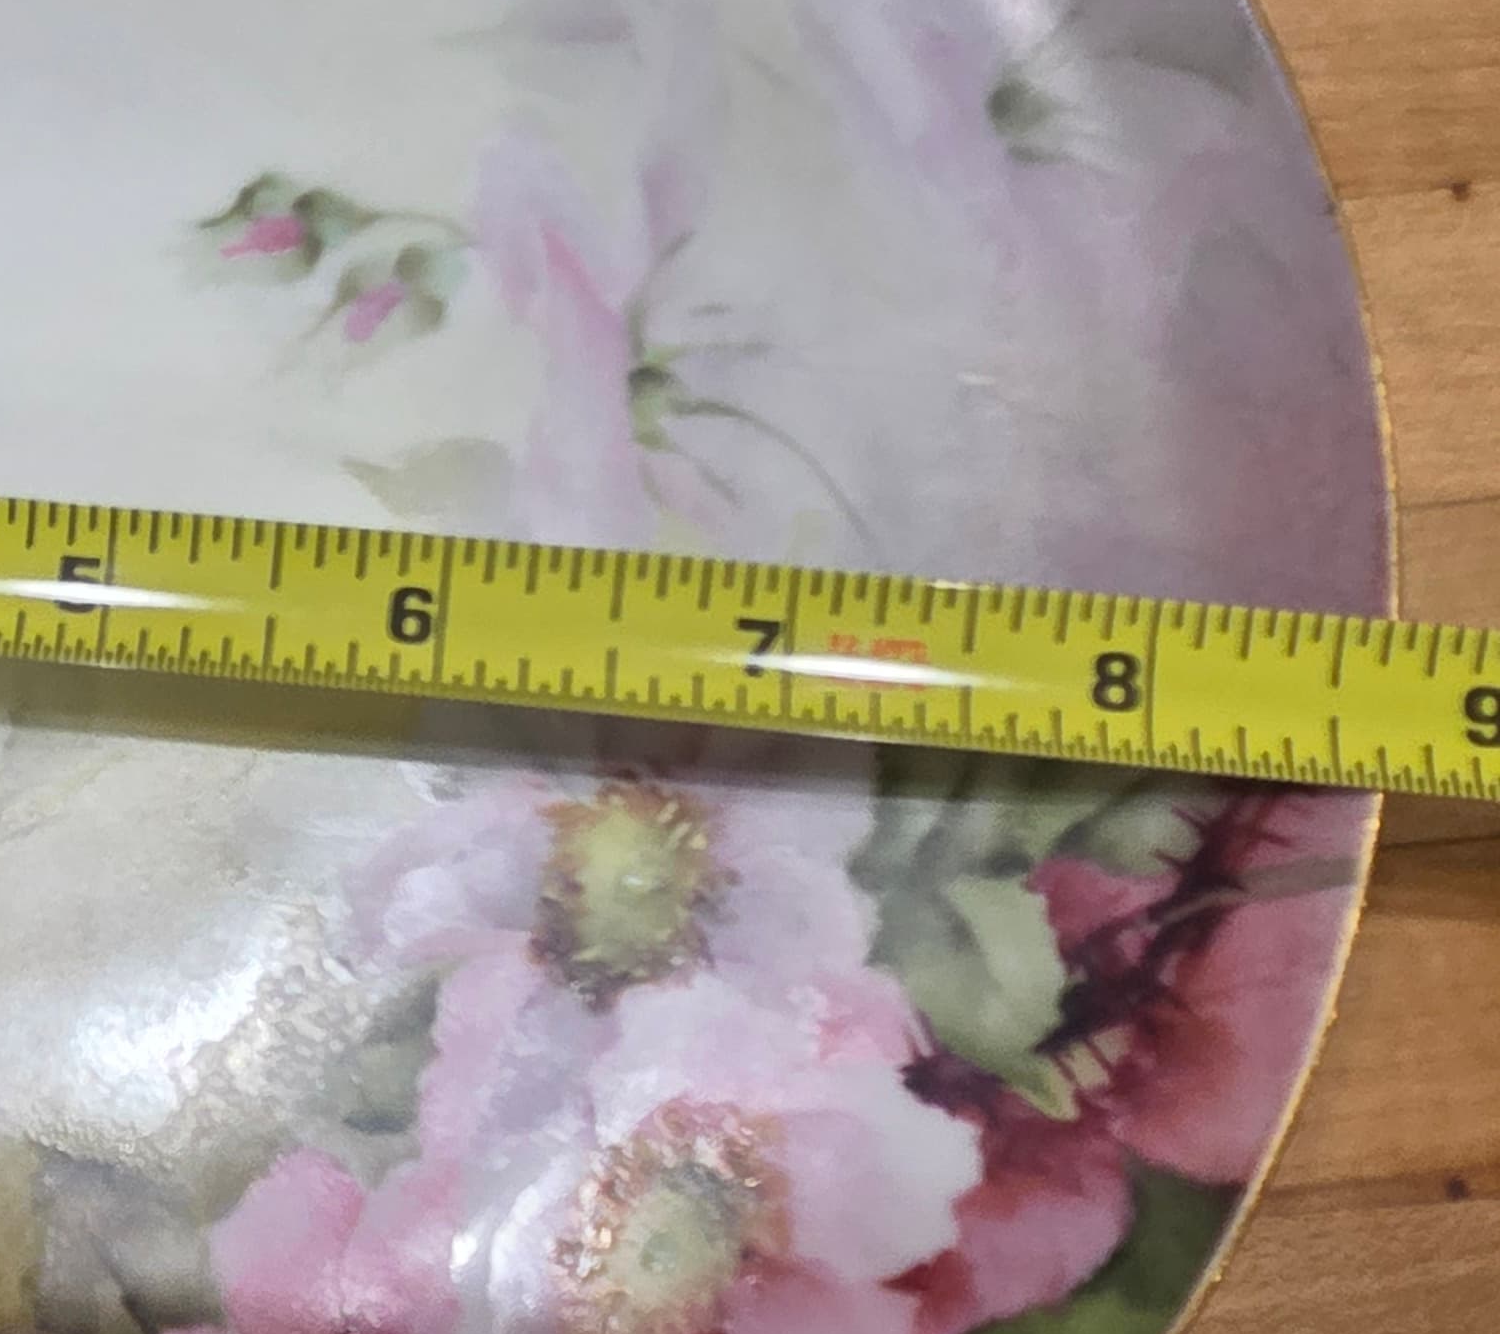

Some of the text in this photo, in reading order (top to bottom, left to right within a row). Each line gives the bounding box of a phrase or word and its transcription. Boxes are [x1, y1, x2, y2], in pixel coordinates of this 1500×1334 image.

[54, 555, 100, 613] 5
[388, 587, 433, 644] 6
[736, 617, 782, 677] 7
[1092, 652, 1140, 712] 8
[1464, 687, 1500, 747] 9
